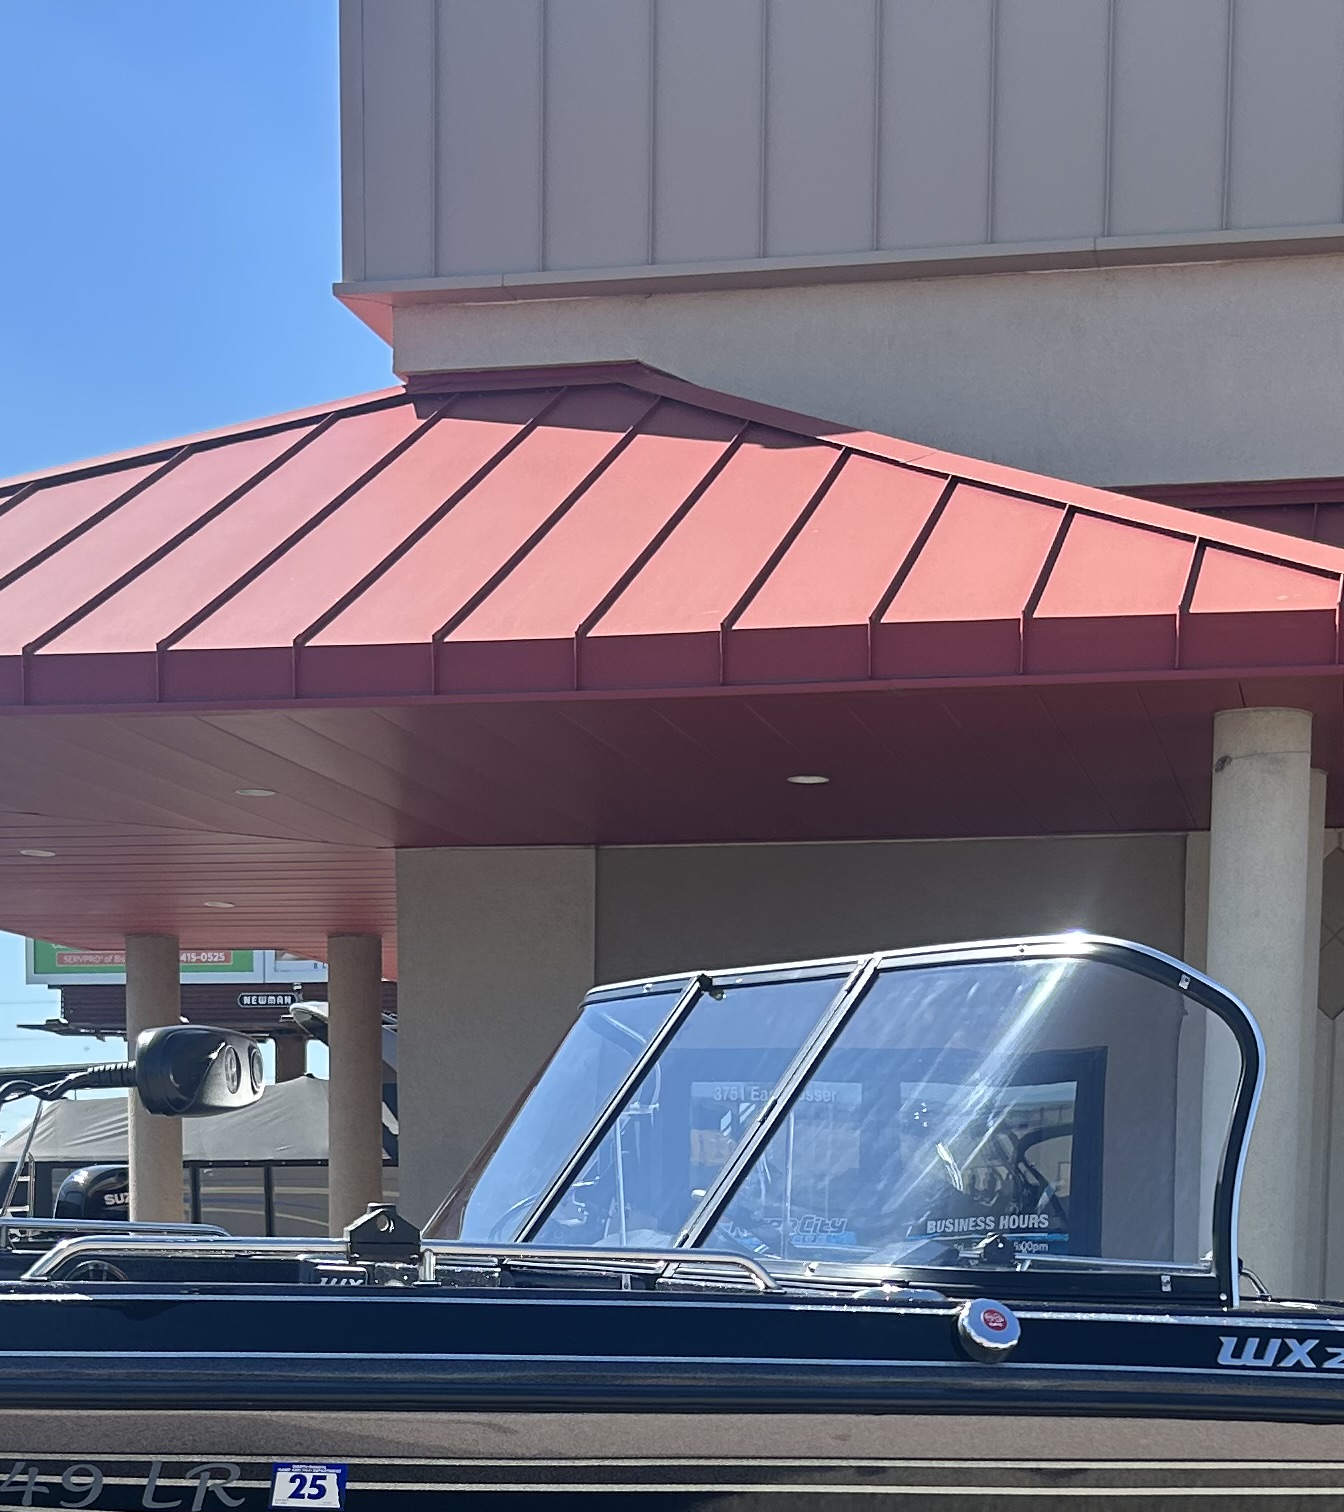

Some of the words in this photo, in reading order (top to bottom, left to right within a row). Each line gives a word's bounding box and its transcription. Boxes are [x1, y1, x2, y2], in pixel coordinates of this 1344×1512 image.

[243, 995, 293, 1005] NEWMAN
[926, 1215, 996, 1234] BUSINESS
[999, 1213, 1050, 1231] HOURS
[1216, 1336, 1320, 1369] WX
[287, 1473, 328, 1500] 25
